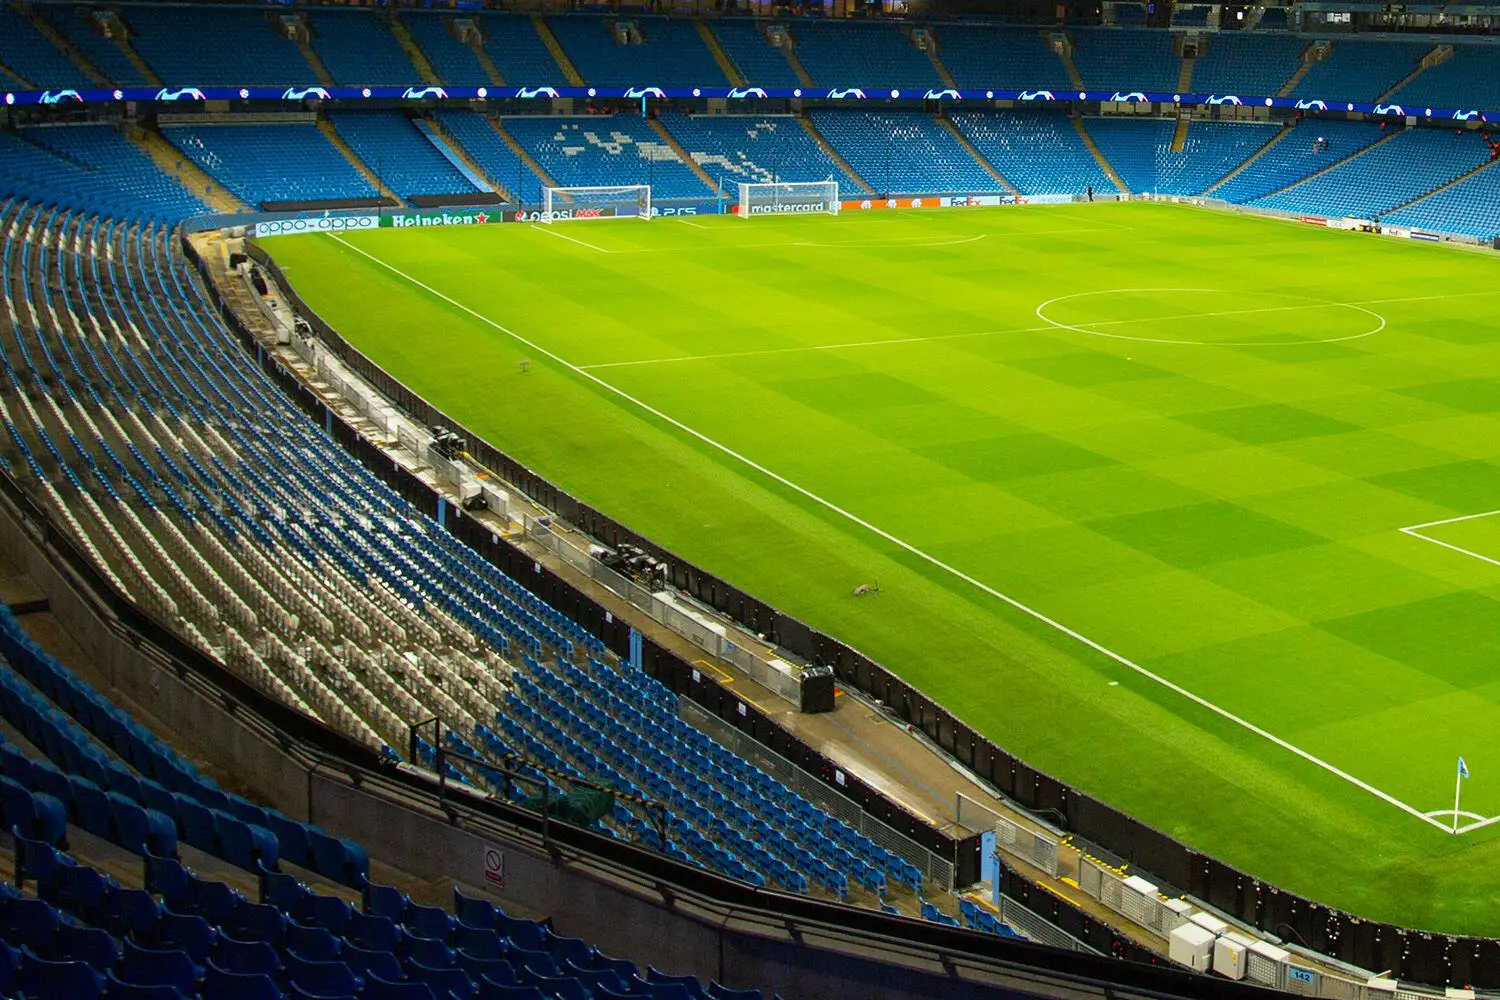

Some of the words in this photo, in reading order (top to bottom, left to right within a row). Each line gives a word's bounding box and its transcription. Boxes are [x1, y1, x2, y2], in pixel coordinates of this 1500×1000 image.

[951, 197, 981, 206] FedEx
[1000, 196, 1029, 205] FedEx
[662, 207, 696, 216] PS5
[752, 202, 823, 213] mastercard
[576, 209, 601, 218] MAX
[259, 220, 306, 234] oppo
[318, 217, 371, 230] oppo
[392, 214, 472, 227] Heineken
[1295, 971, 1310, 982] 142
